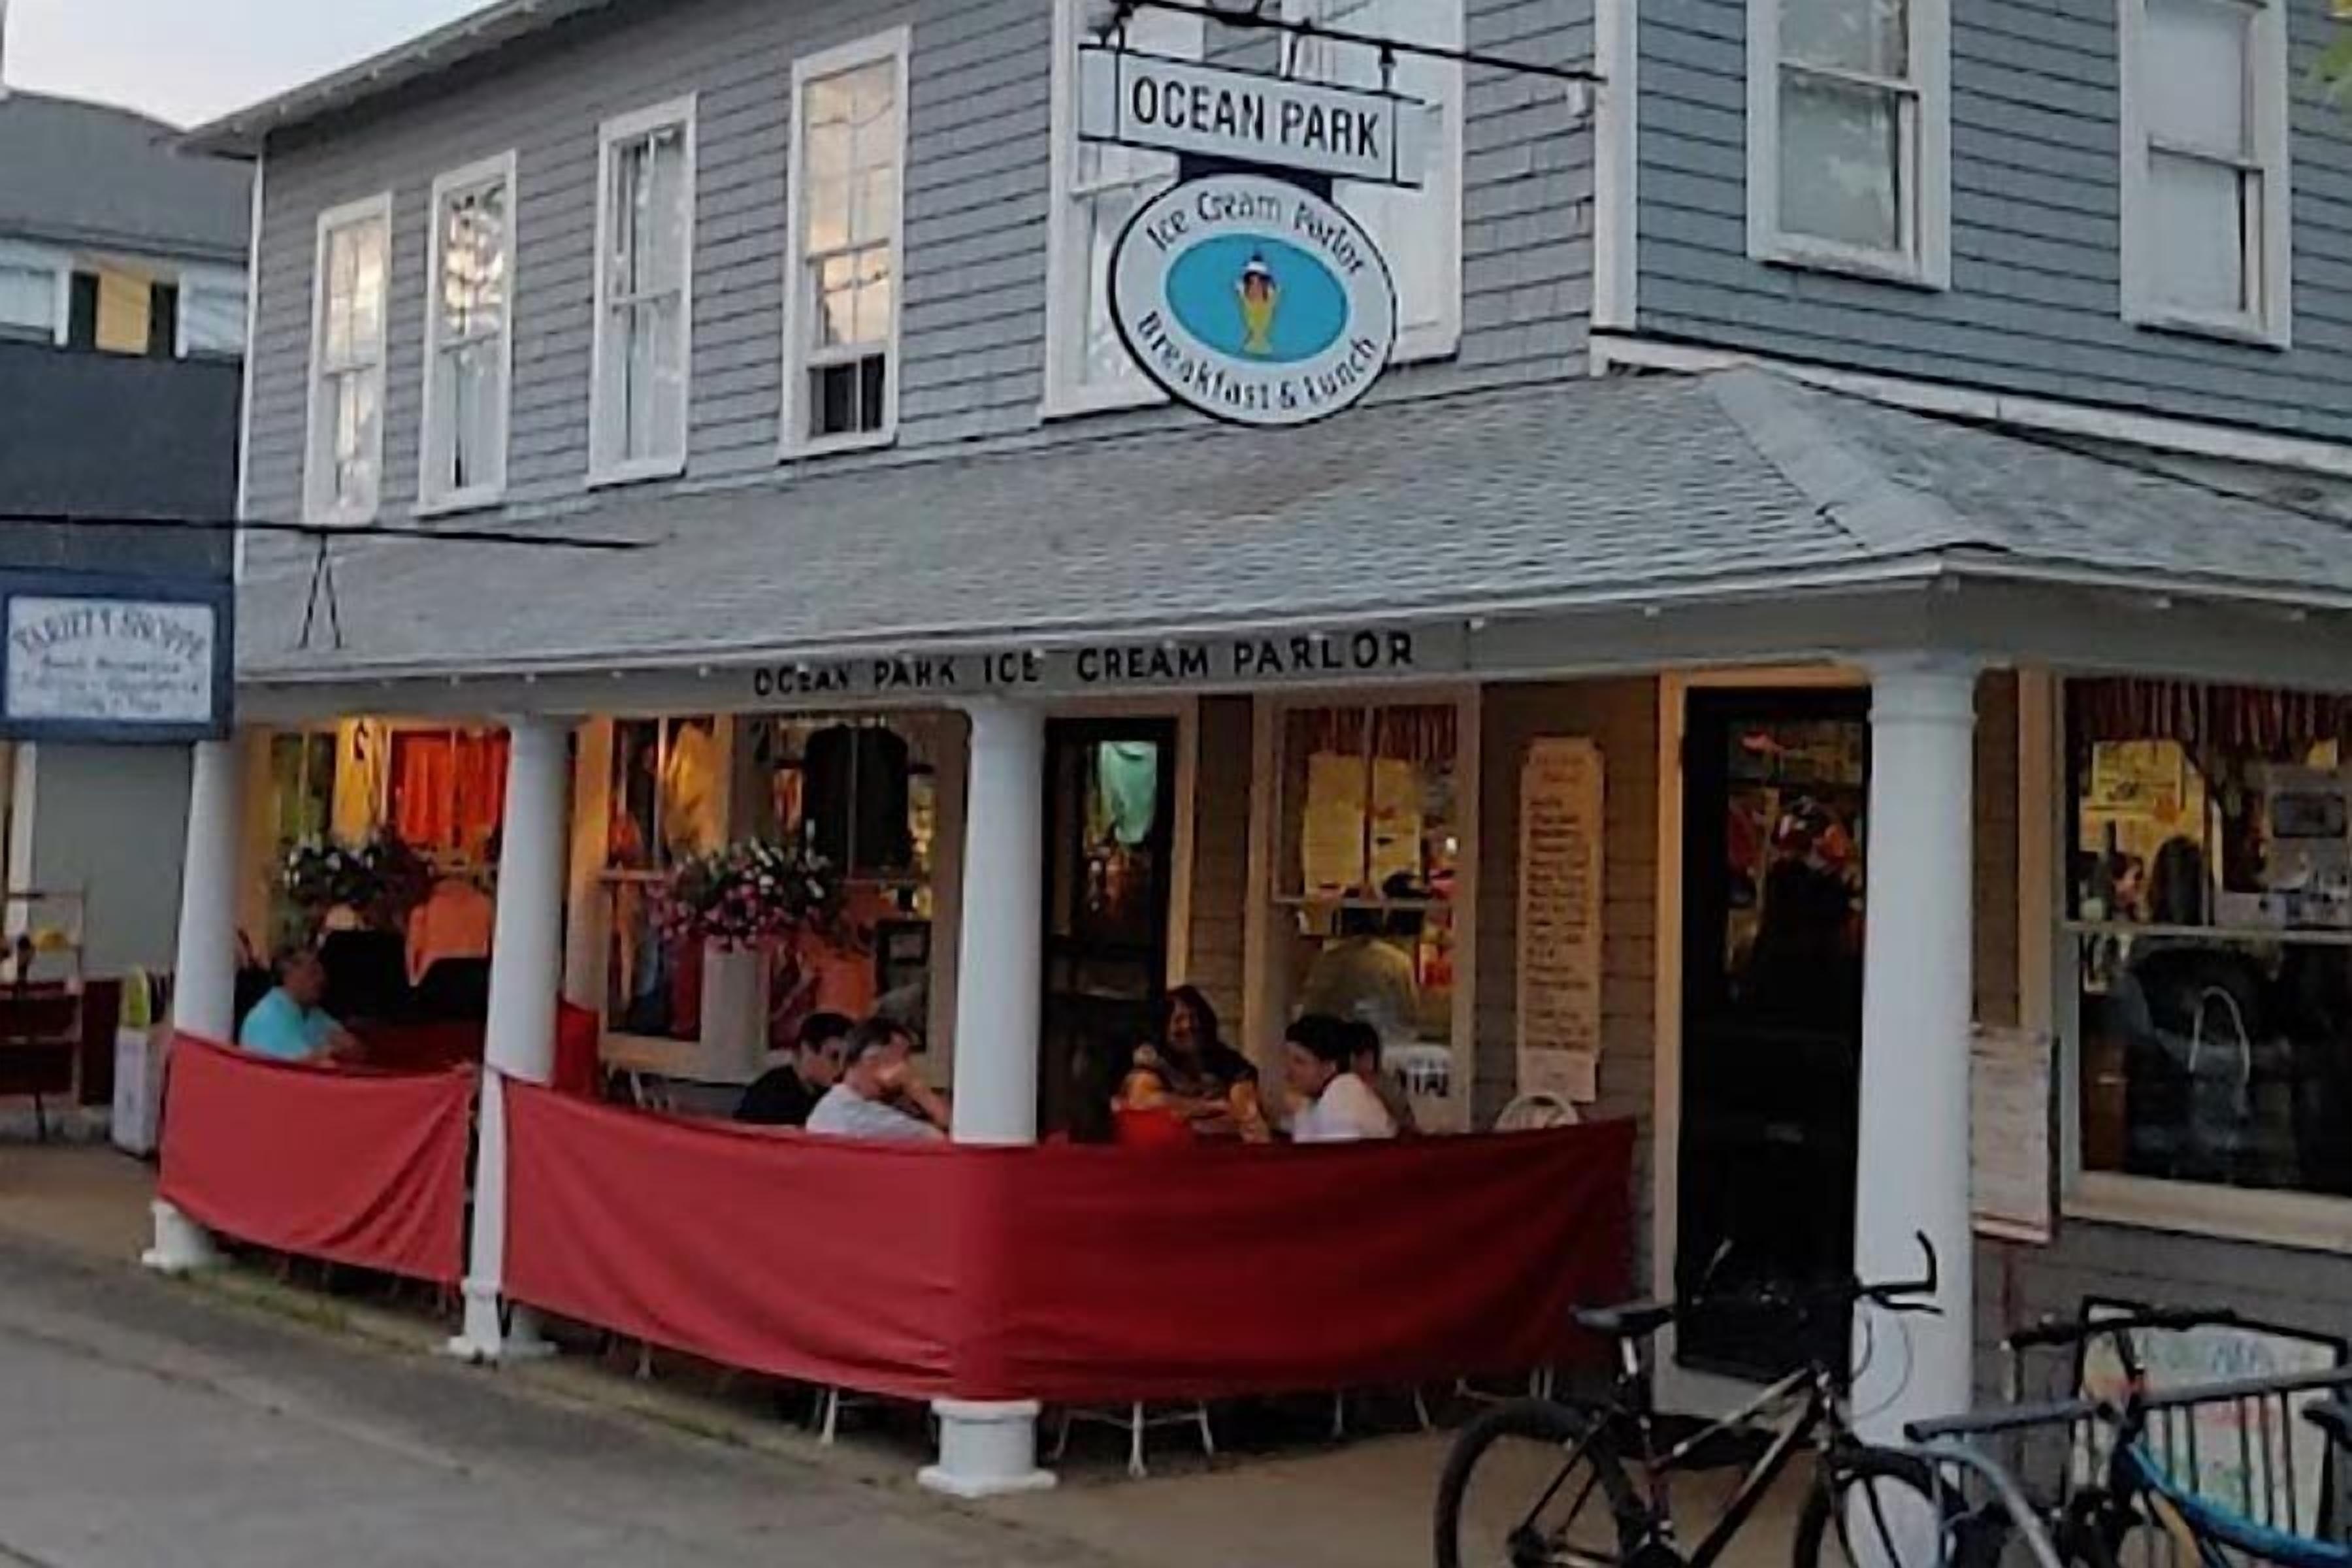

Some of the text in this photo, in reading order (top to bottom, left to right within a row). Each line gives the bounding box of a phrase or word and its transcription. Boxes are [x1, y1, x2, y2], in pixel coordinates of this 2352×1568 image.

[1132, 75, 1379, 158] OCEAN PARK
[1146, 189, 1364, 274] Ice Cream Parlor
[1137, 310, 1376, 410] Breakfast & Lunch
[754, 629, 1413, 696] OCEAN PARK ICE CREAM PARLOR
